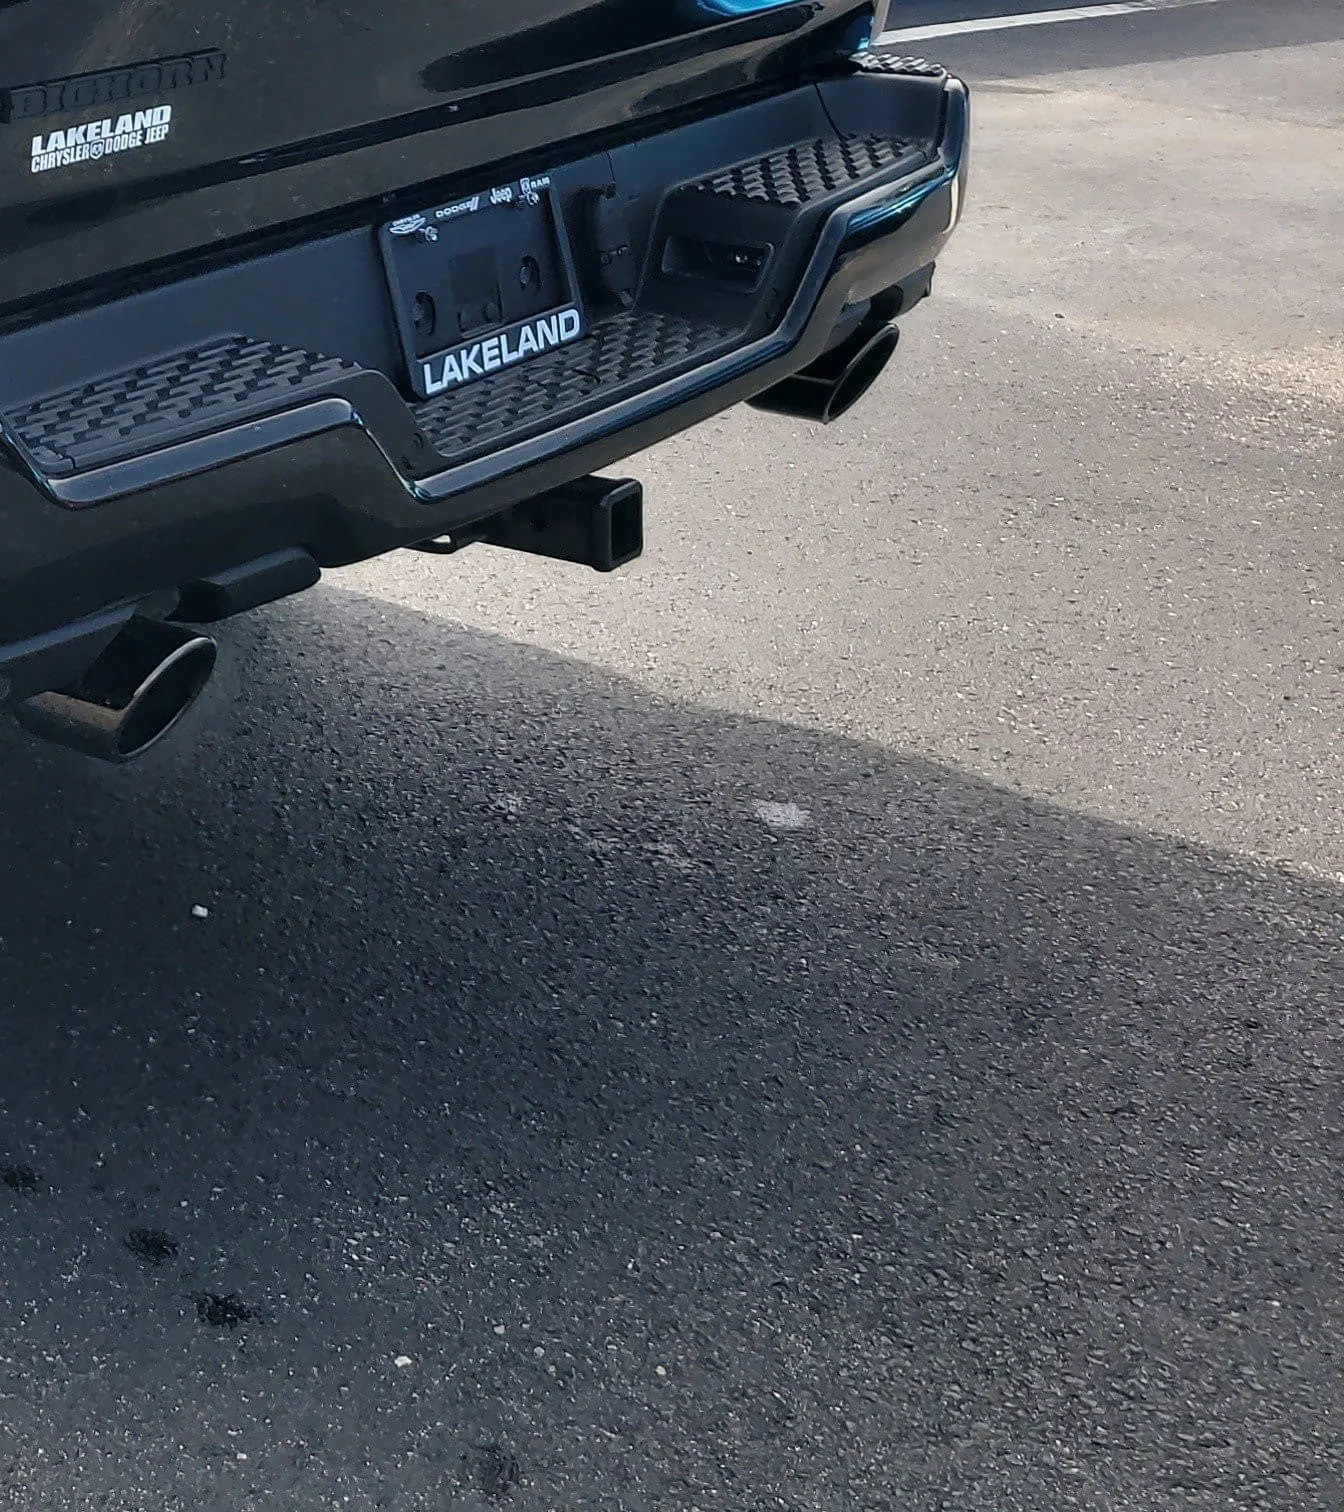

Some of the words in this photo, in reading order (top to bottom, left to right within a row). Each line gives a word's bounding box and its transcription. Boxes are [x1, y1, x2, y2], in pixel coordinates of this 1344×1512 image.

[31, 104, 172, 156] LAKELAND
[31, 146, 90, 173] CHRYSLER
[105, 132, 143, 154] DODGE
[144, 124, 169, 145] JEEP
[423, 308, 581, 396] LAKELAND
